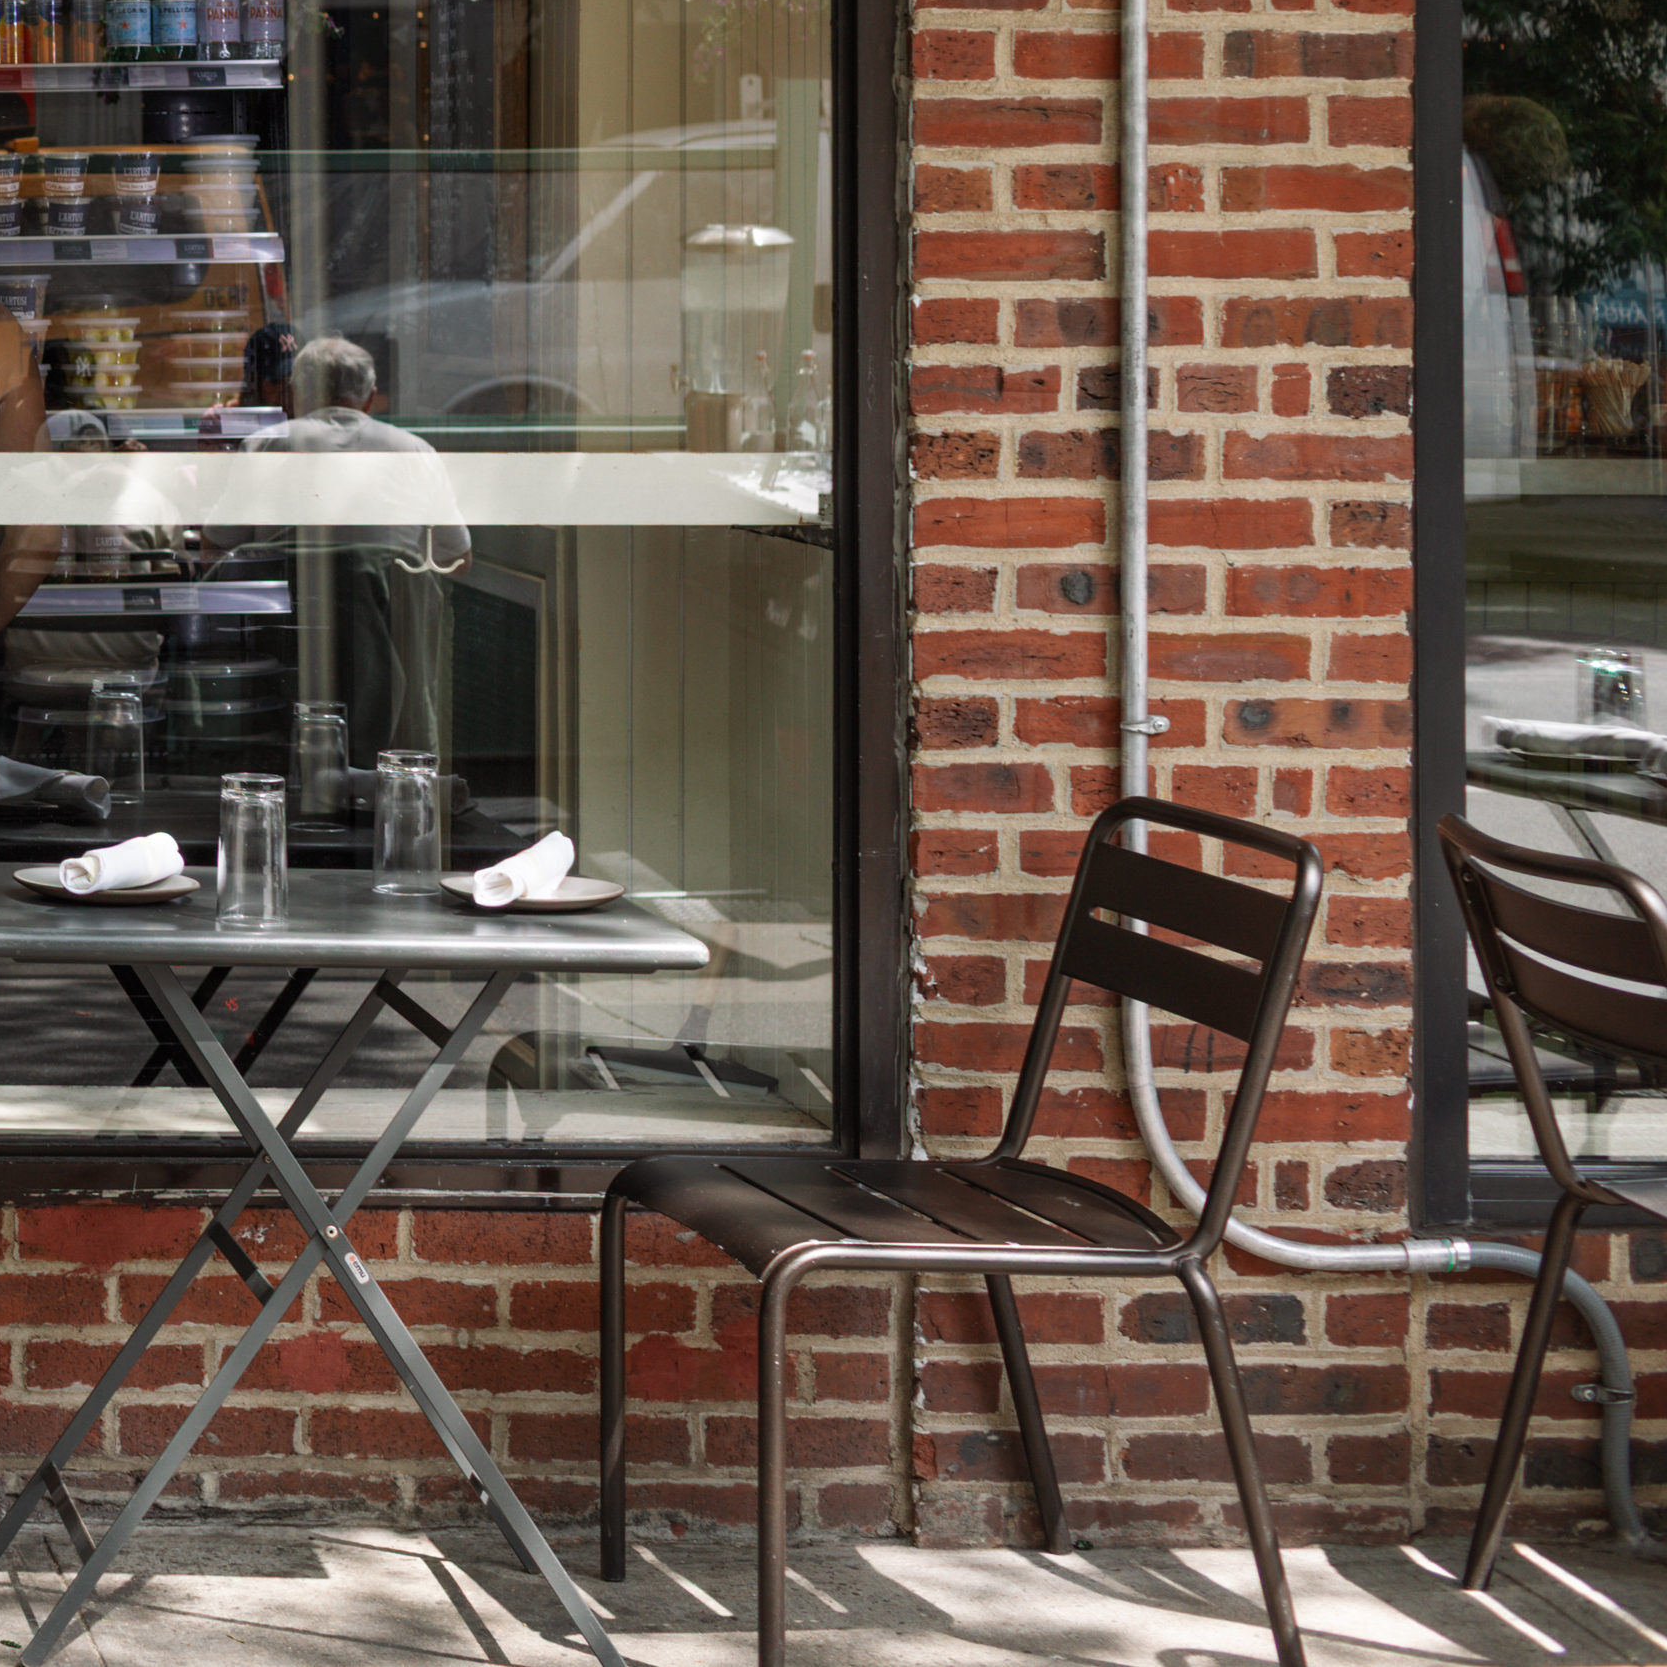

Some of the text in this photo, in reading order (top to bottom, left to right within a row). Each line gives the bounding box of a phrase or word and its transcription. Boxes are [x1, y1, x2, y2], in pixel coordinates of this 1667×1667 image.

[207, 7, 240, 21] PANNA
[250, 6, 283, 19] PANNA
[0, 295, 27, 306] L'ARTUSI
